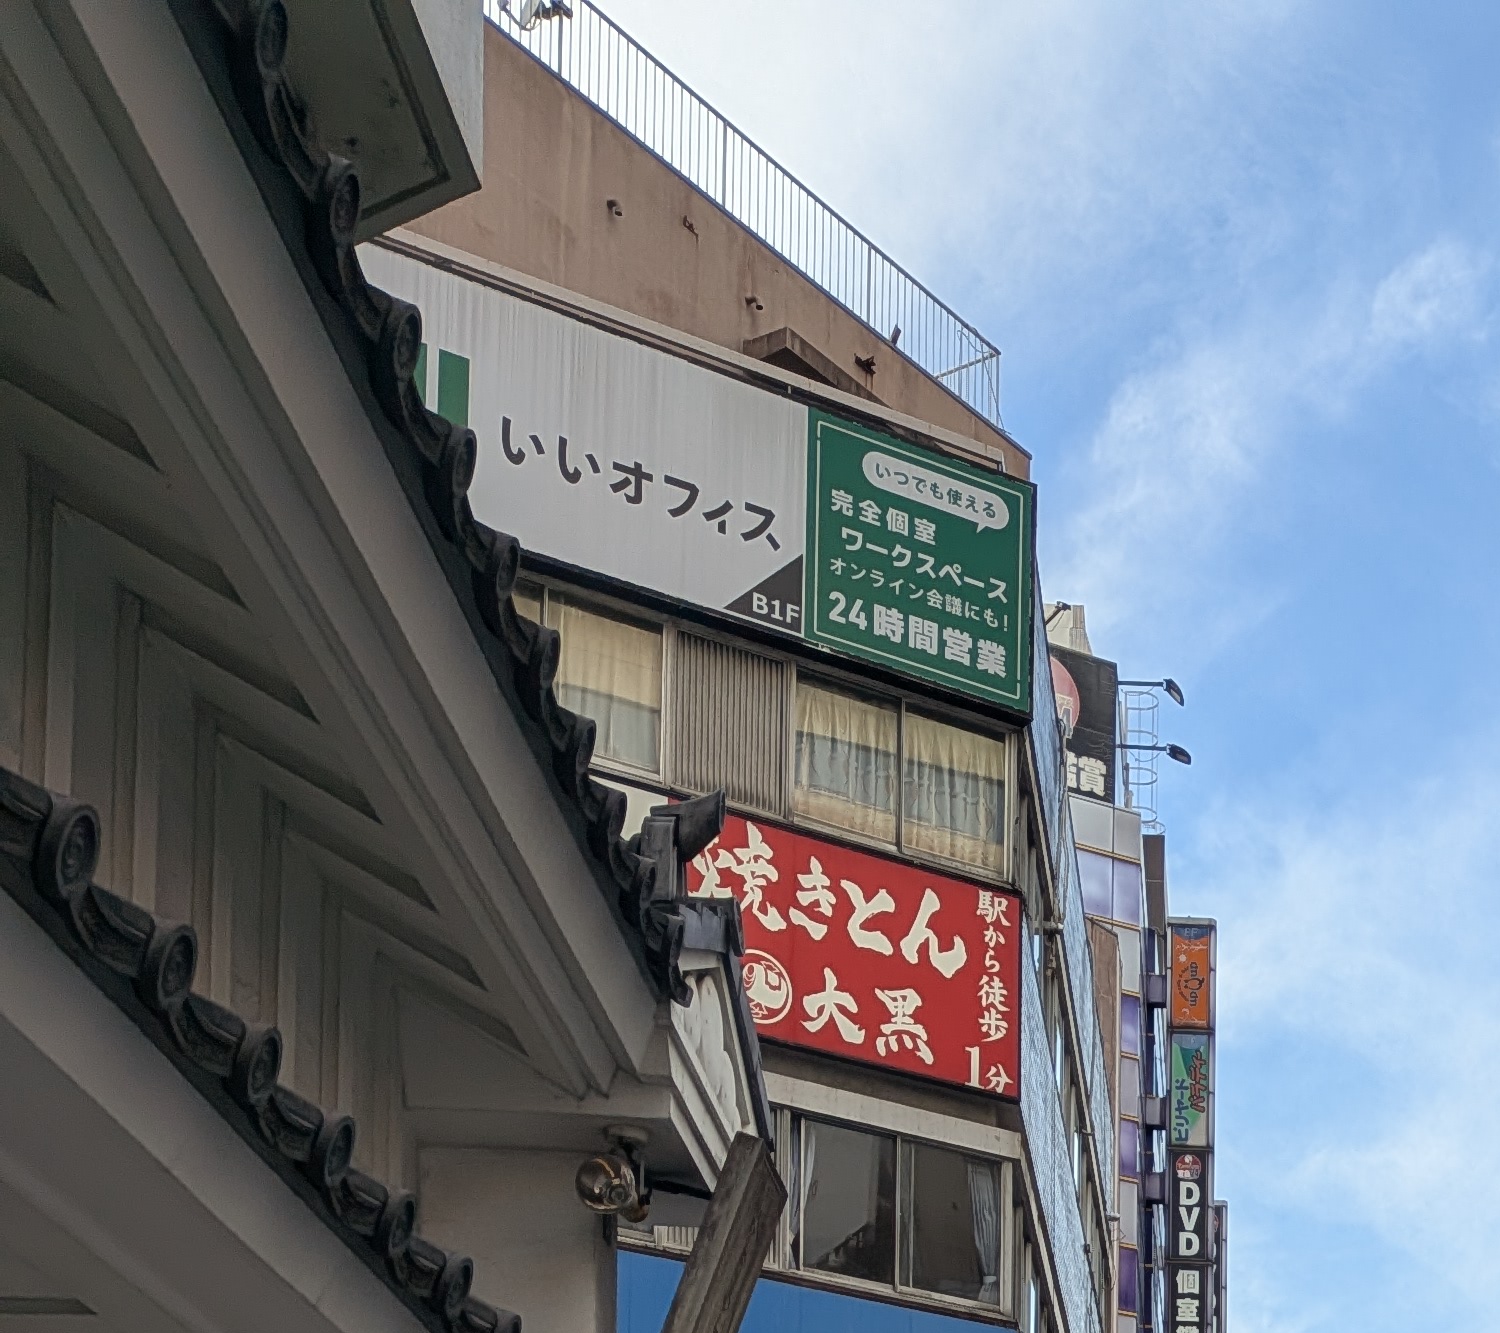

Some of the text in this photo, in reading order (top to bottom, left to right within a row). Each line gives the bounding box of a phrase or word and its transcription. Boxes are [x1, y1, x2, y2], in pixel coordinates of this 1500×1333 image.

[500, 415, 782, 552] いいオフィス
[830, 489, 937, 546] 完全個室
[874, 461, 998, 520] いつでも使える
[841, 528, 1009, 603] ワークスペース
[751, 592, 799, 626] B1F
[828, 591, 1007, 679] 24時間営業
[690, 821, 968, 978] 焼きとん
[801, 968, 934, 1065] 大黒
[965, 890, 1013, 1094] 駅から徒歩1分
[1179, 1181, 1200, 1256] DVD
